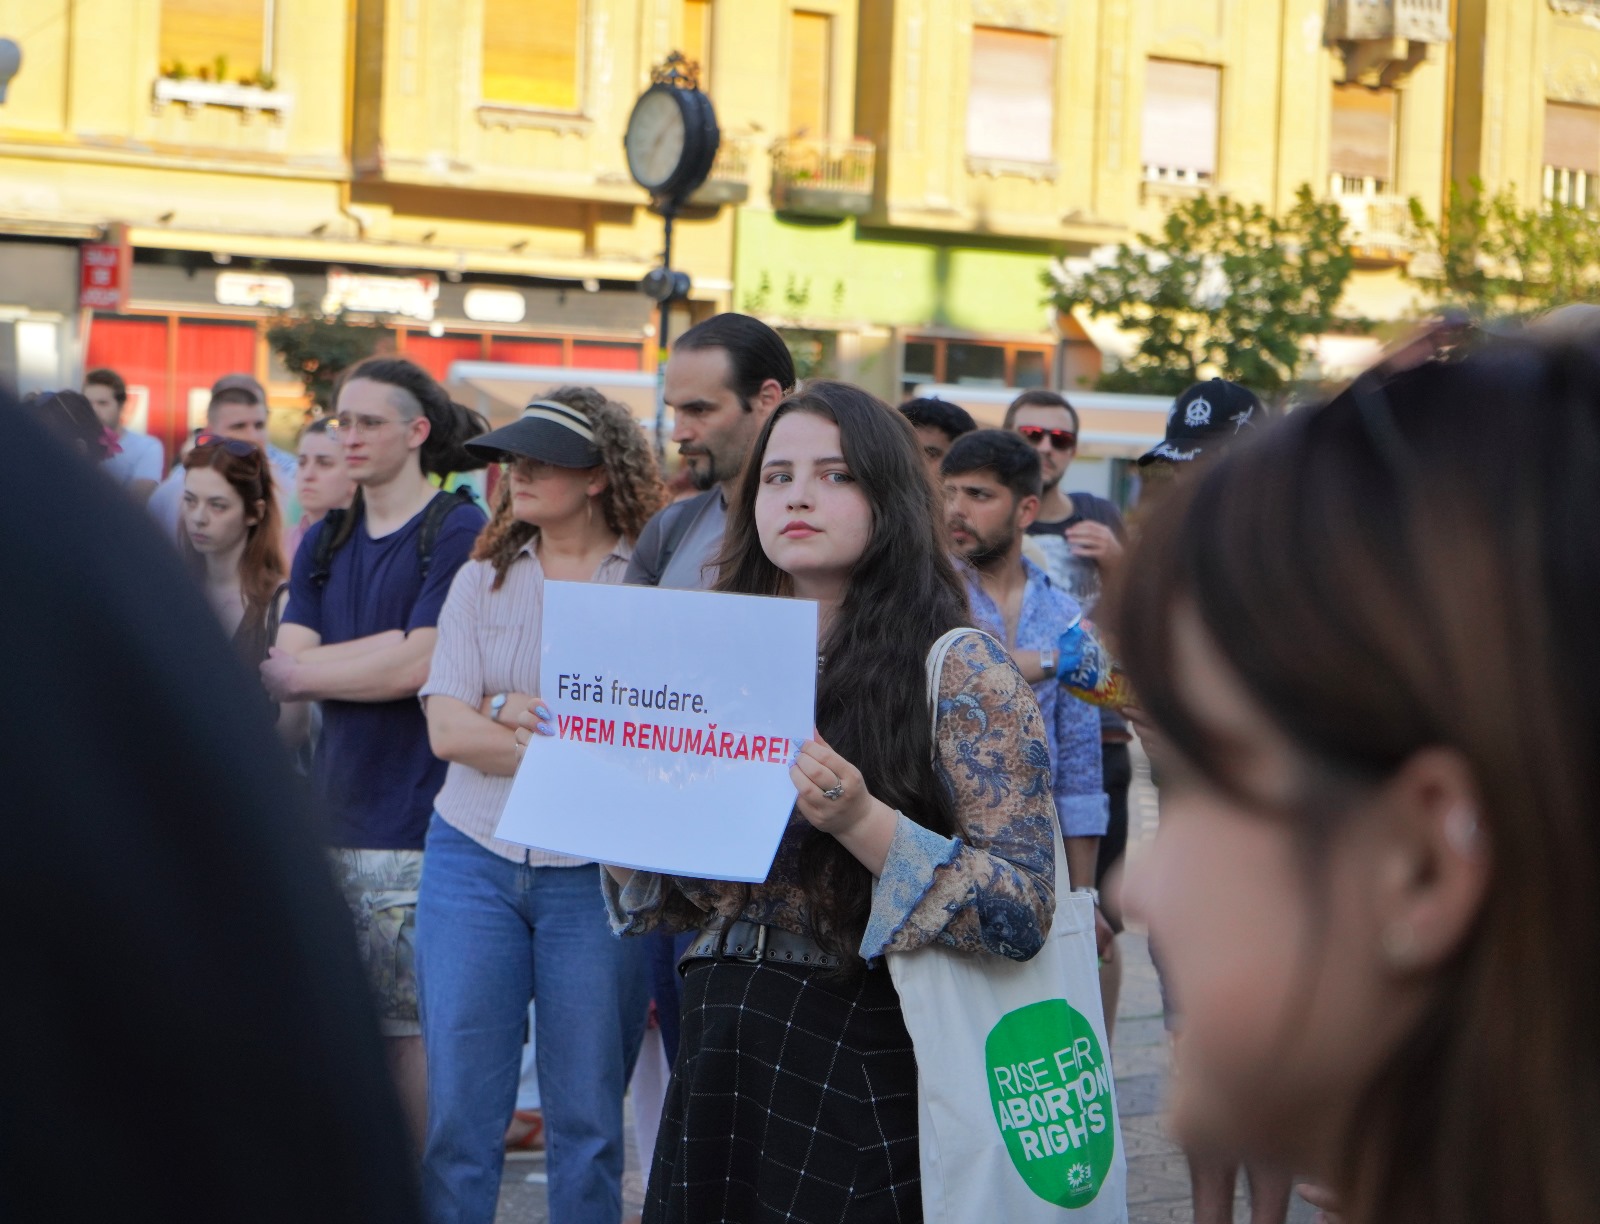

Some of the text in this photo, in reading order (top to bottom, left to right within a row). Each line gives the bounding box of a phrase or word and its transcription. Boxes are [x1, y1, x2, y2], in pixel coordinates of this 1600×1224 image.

[557, 673, 709, 714] Fără fraudare.
[557, 714, 790, 764] VREM RENUMĂRARE!
[994, 1037, 1095, 1097] RISE FR
[998, 1063, 1110, 1131] ABORTON
[1018, 1102, 1106, 1161] RIGHS
